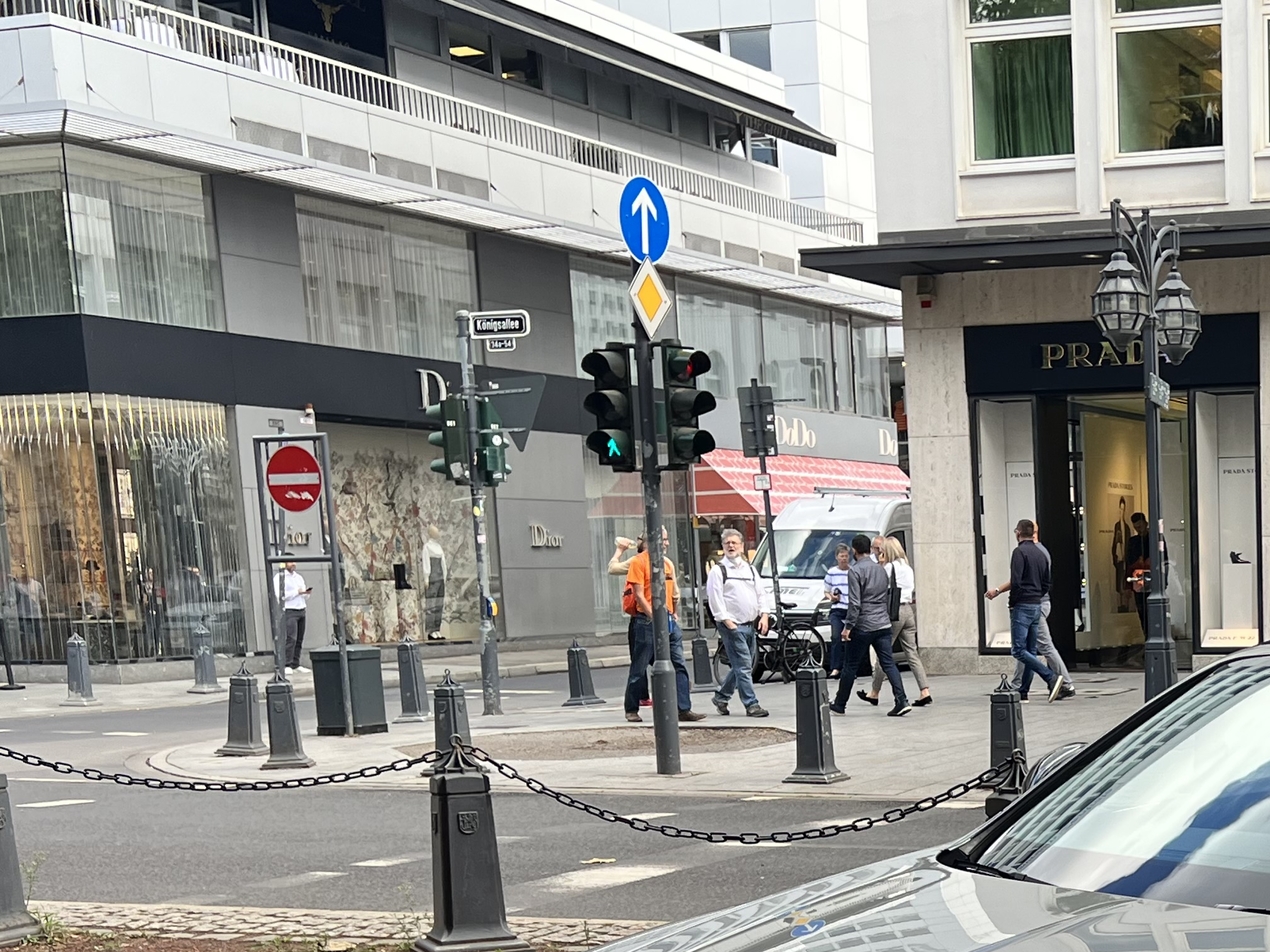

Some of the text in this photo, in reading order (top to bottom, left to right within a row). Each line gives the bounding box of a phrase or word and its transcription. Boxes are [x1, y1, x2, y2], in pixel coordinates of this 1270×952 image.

[476, 318, 520, 332] Königsallee
[1040, 339, 1173, 370] PRAD
[529, 523, 565, 547] Dior
